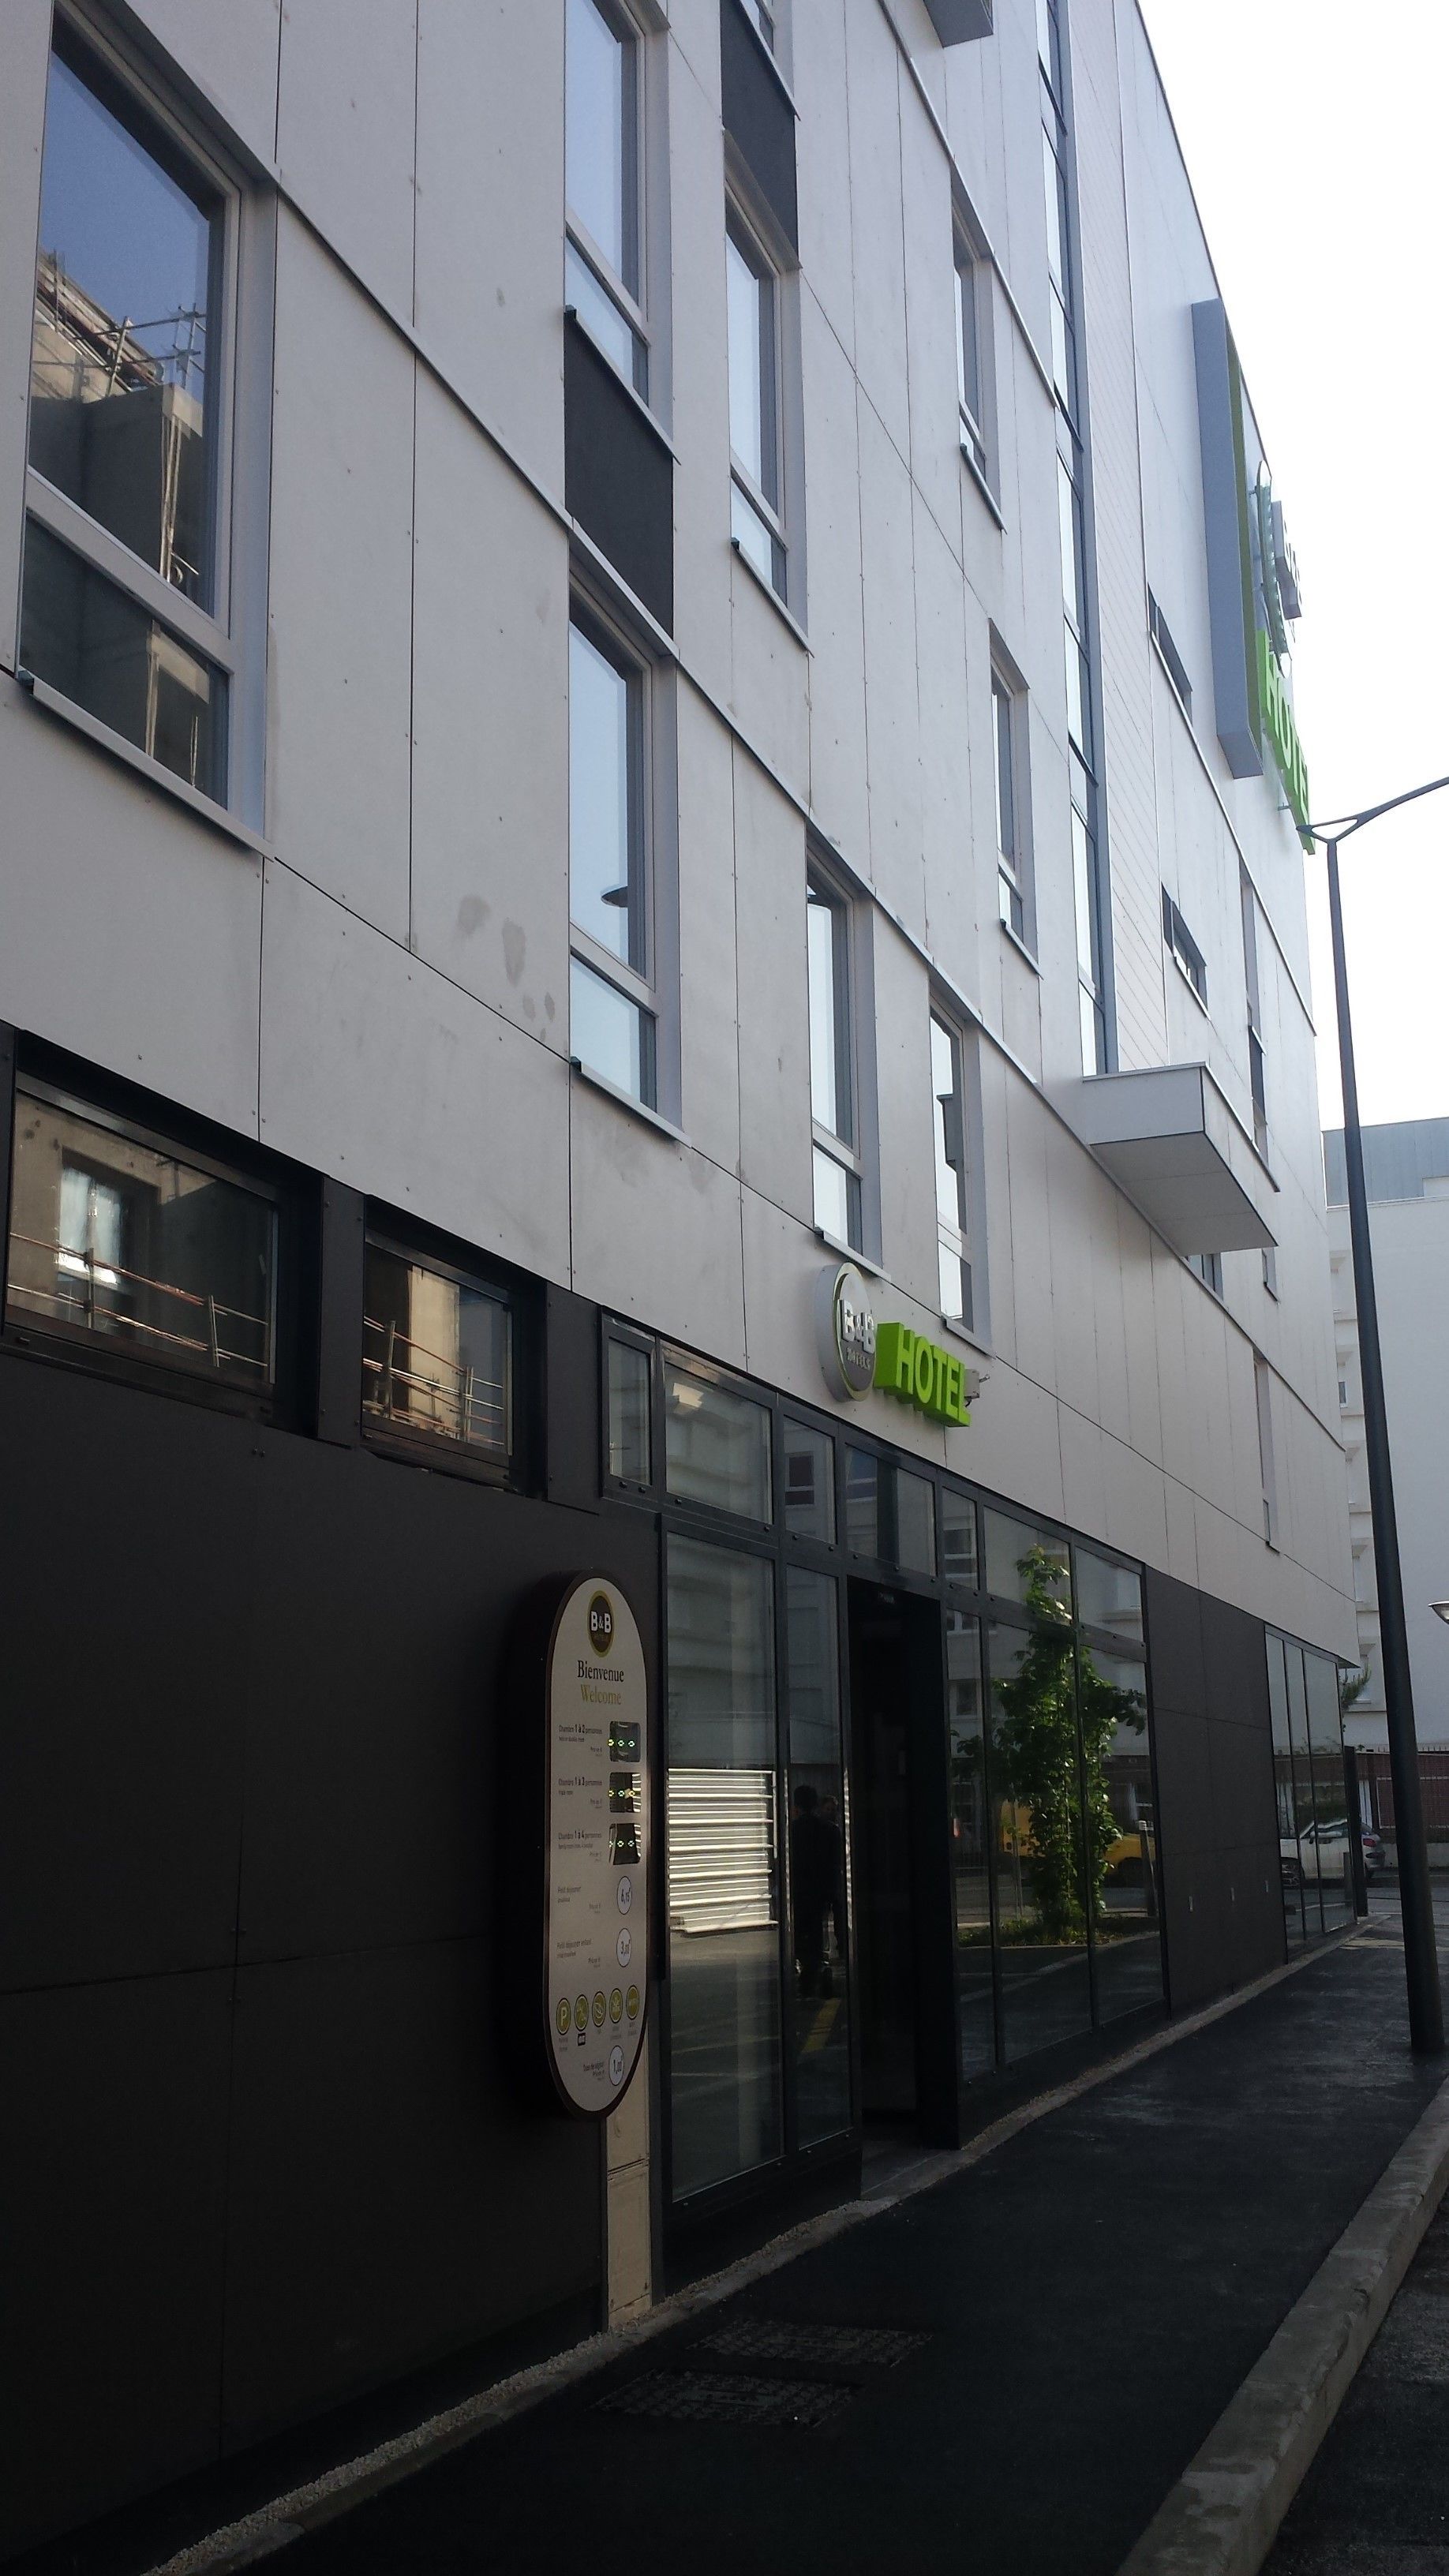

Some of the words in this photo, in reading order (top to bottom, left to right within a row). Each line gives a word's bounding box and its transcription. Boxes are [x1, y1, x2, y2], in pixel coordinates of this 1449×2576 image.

[878, 1322, 971, 1427] HOTEL
[590, 1610, 612, 1634] B&B
[577, 1660, 624, 1683] Bienvenue
[580, 1683, 622, 1705] Welcome
